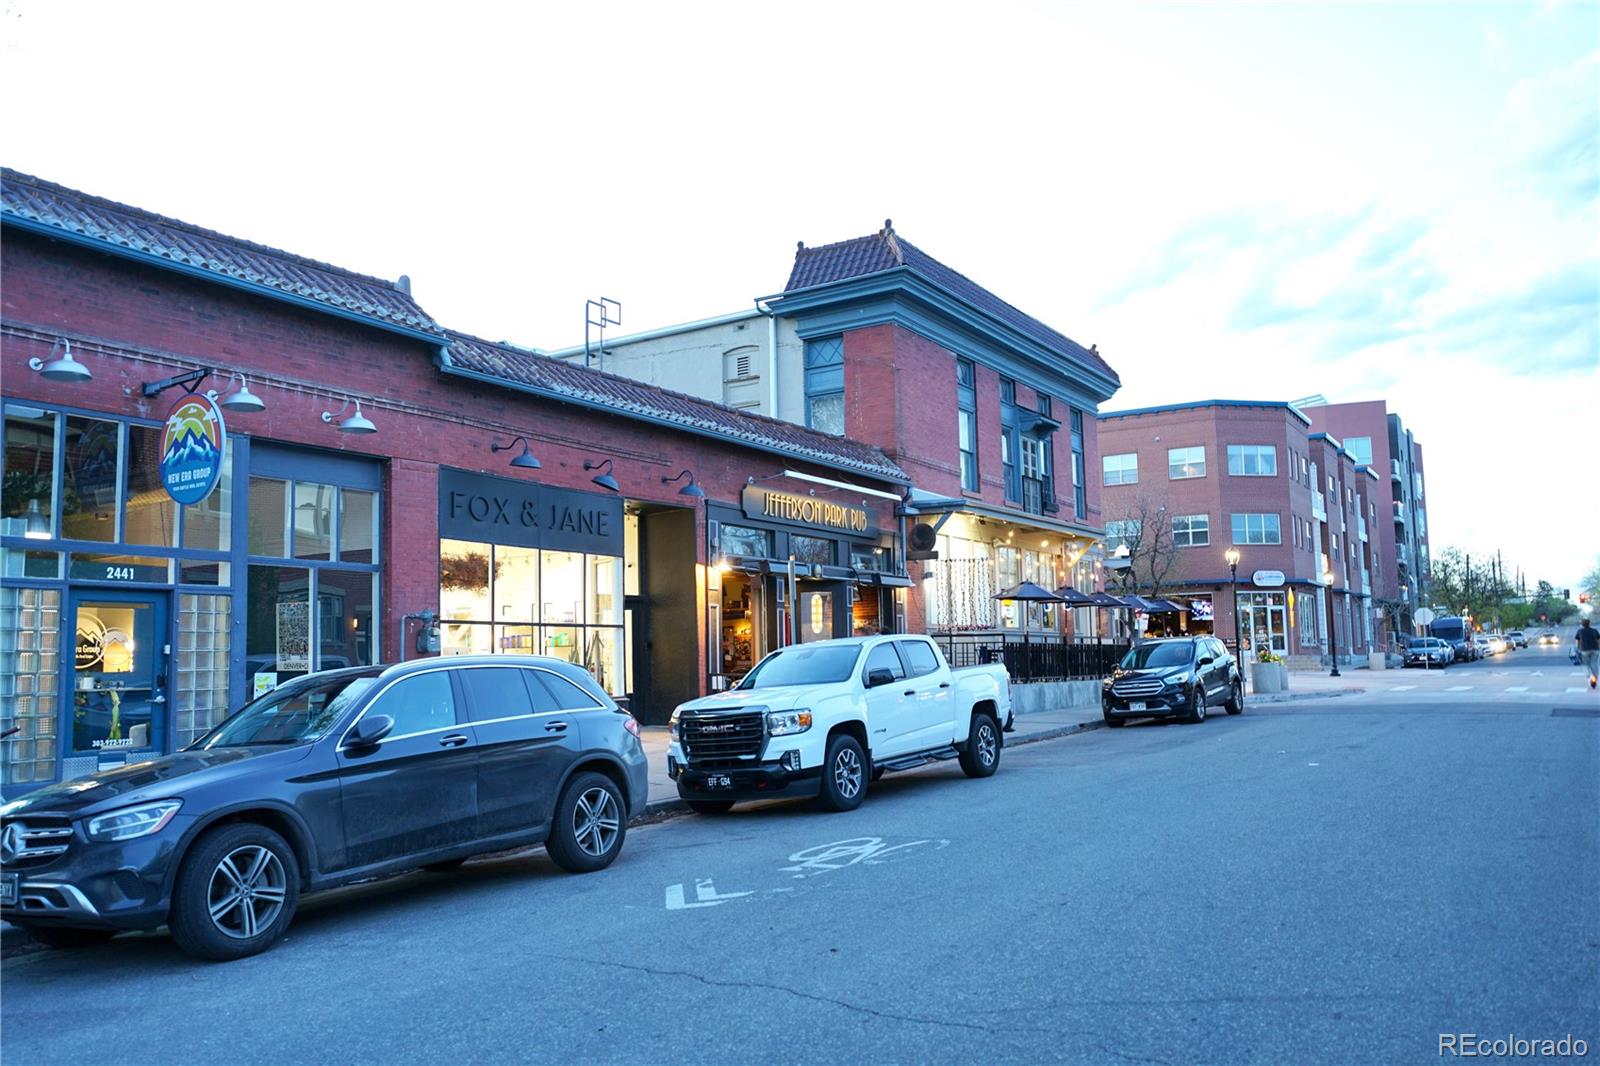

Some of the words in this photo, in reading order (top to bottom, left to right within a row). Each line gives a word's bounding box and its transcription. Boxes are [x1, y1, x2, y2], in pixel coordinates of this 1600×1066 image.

[168, 472, 180, 484] NEW
[181, 470, 192, 482] ERA
[193, 467, 211, 480] GROUP
[450, 491, 510, 525] FOX
[520, 500, 538, 527] &
[548, 504, 609, 537] JANE
[764, 492, 821, 524] JEFFERSON
[824, 503, 849, 529] PARK
[851, 508, 868, 532] PUB
[106, 566, 134, 580] 2441
[702, 724, 734, 733] GMC
